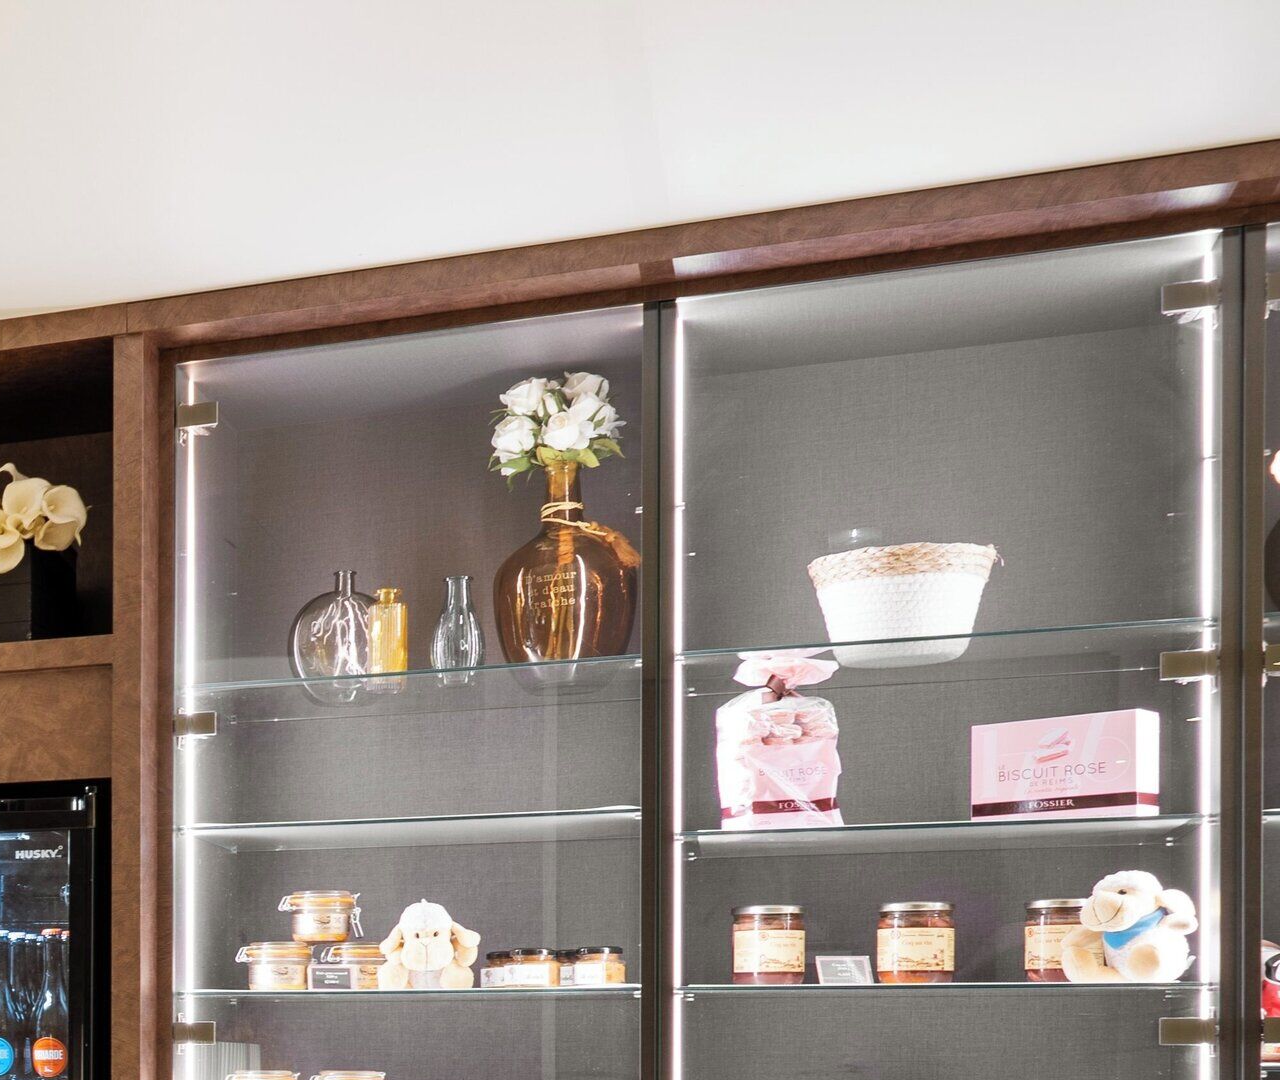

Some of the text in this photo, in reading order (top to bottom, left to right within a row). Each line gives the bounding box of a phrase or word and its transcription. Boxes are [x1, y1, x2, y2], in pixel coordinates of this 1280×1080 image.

[998, 761, 1107, 782] BISCUIT ROSE
[1028, 799, 1075, 809] FOSSIER
[15, 849, 59, 860] HUSKY
